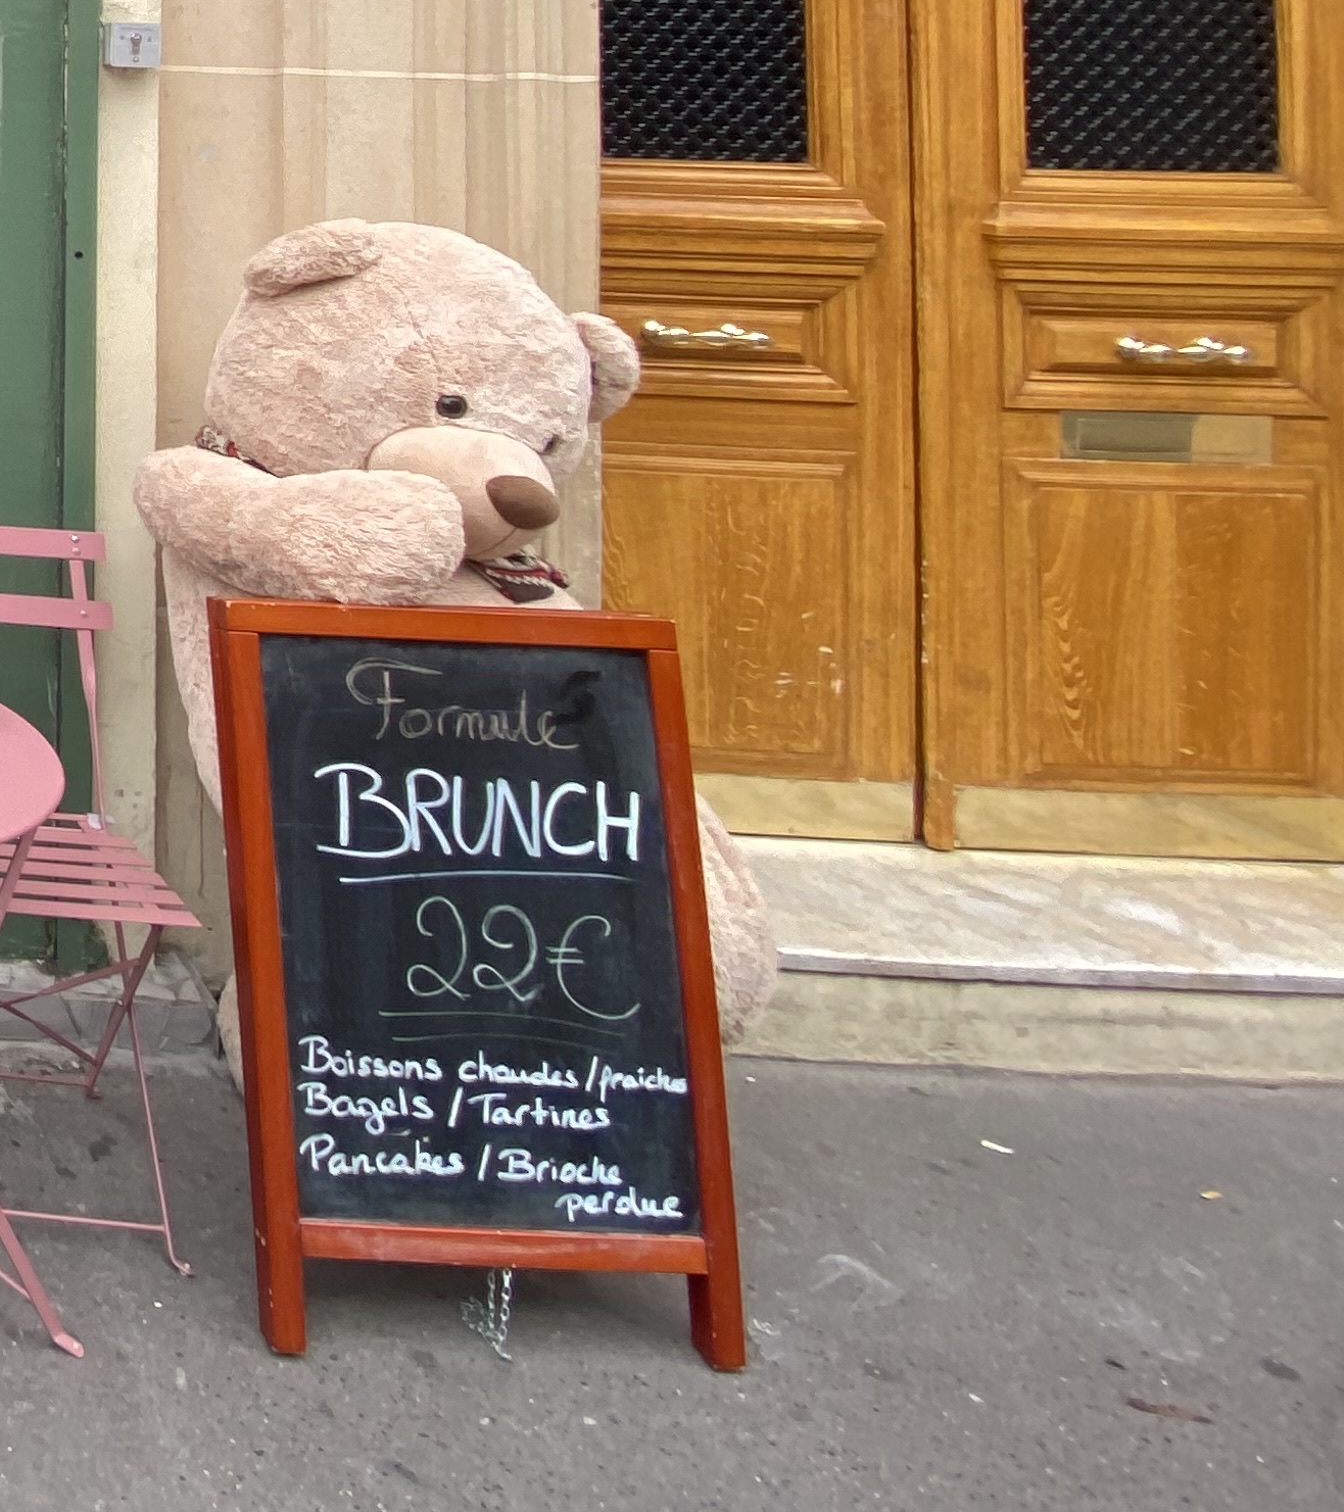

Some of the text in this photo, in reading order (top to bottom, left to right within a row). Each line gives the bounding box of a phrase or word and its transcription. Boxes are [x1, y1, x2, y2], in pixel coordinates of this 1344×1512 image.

[345, 656, 580, 752] Formule
[313, 762, 639, 863] BRUNCH
[407, 895, 641, 1020] 22€
[297, 1035, 443, 1081] Boissons
[457, 1050, 578, 1090] chaudes
[296, 1081, 435, 1136] Bagels
[467, 1092, 611, 1130] Tartines
[298, 1133, 465, 1178] Pancakes
[496, 1148, 624, 1186] Brioche
[554, 1187, 685, 1222] perdue
